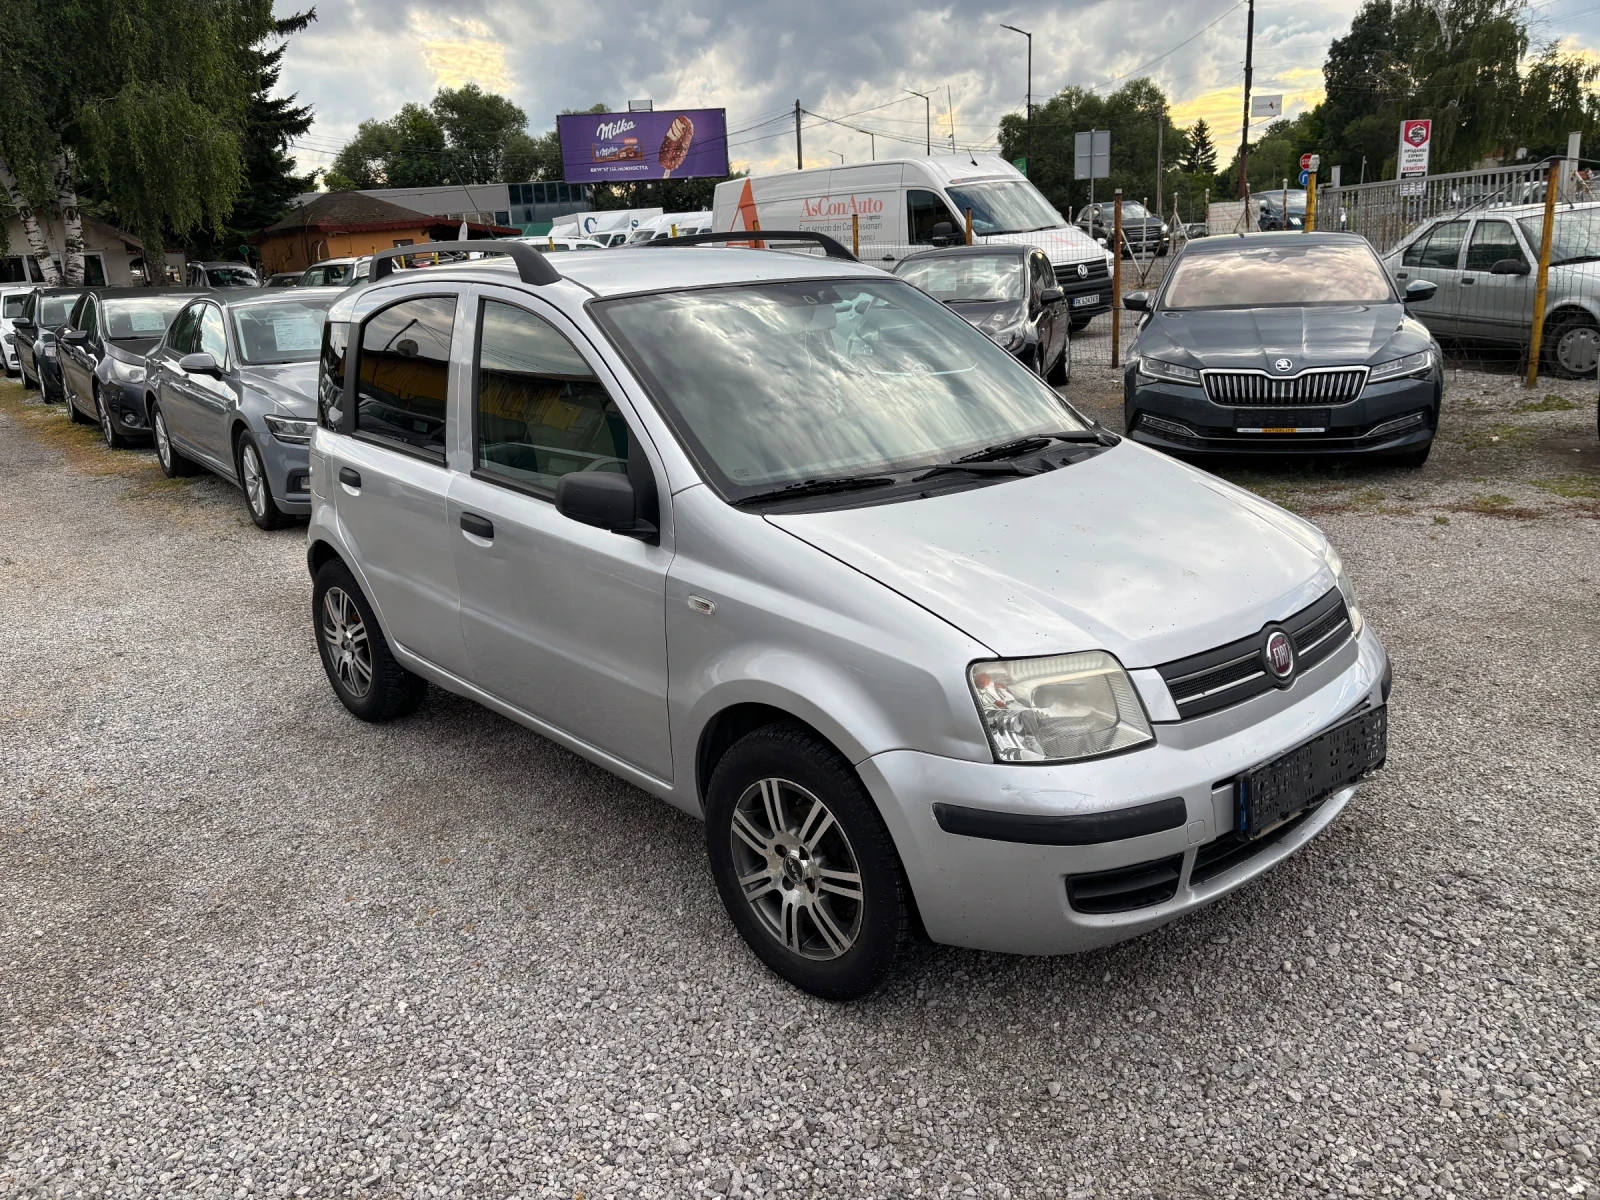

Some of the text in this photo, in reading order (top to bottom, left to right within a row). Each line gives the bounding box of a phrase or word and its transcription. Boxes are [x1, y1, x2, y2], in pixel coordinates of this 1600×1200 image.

[596, 118, 636, 141] Milka
[800, 193, 884, 218] AsConAuto
[832, 222, 842, 232] dei
[1273, 643, 1288, 669] FIAT
